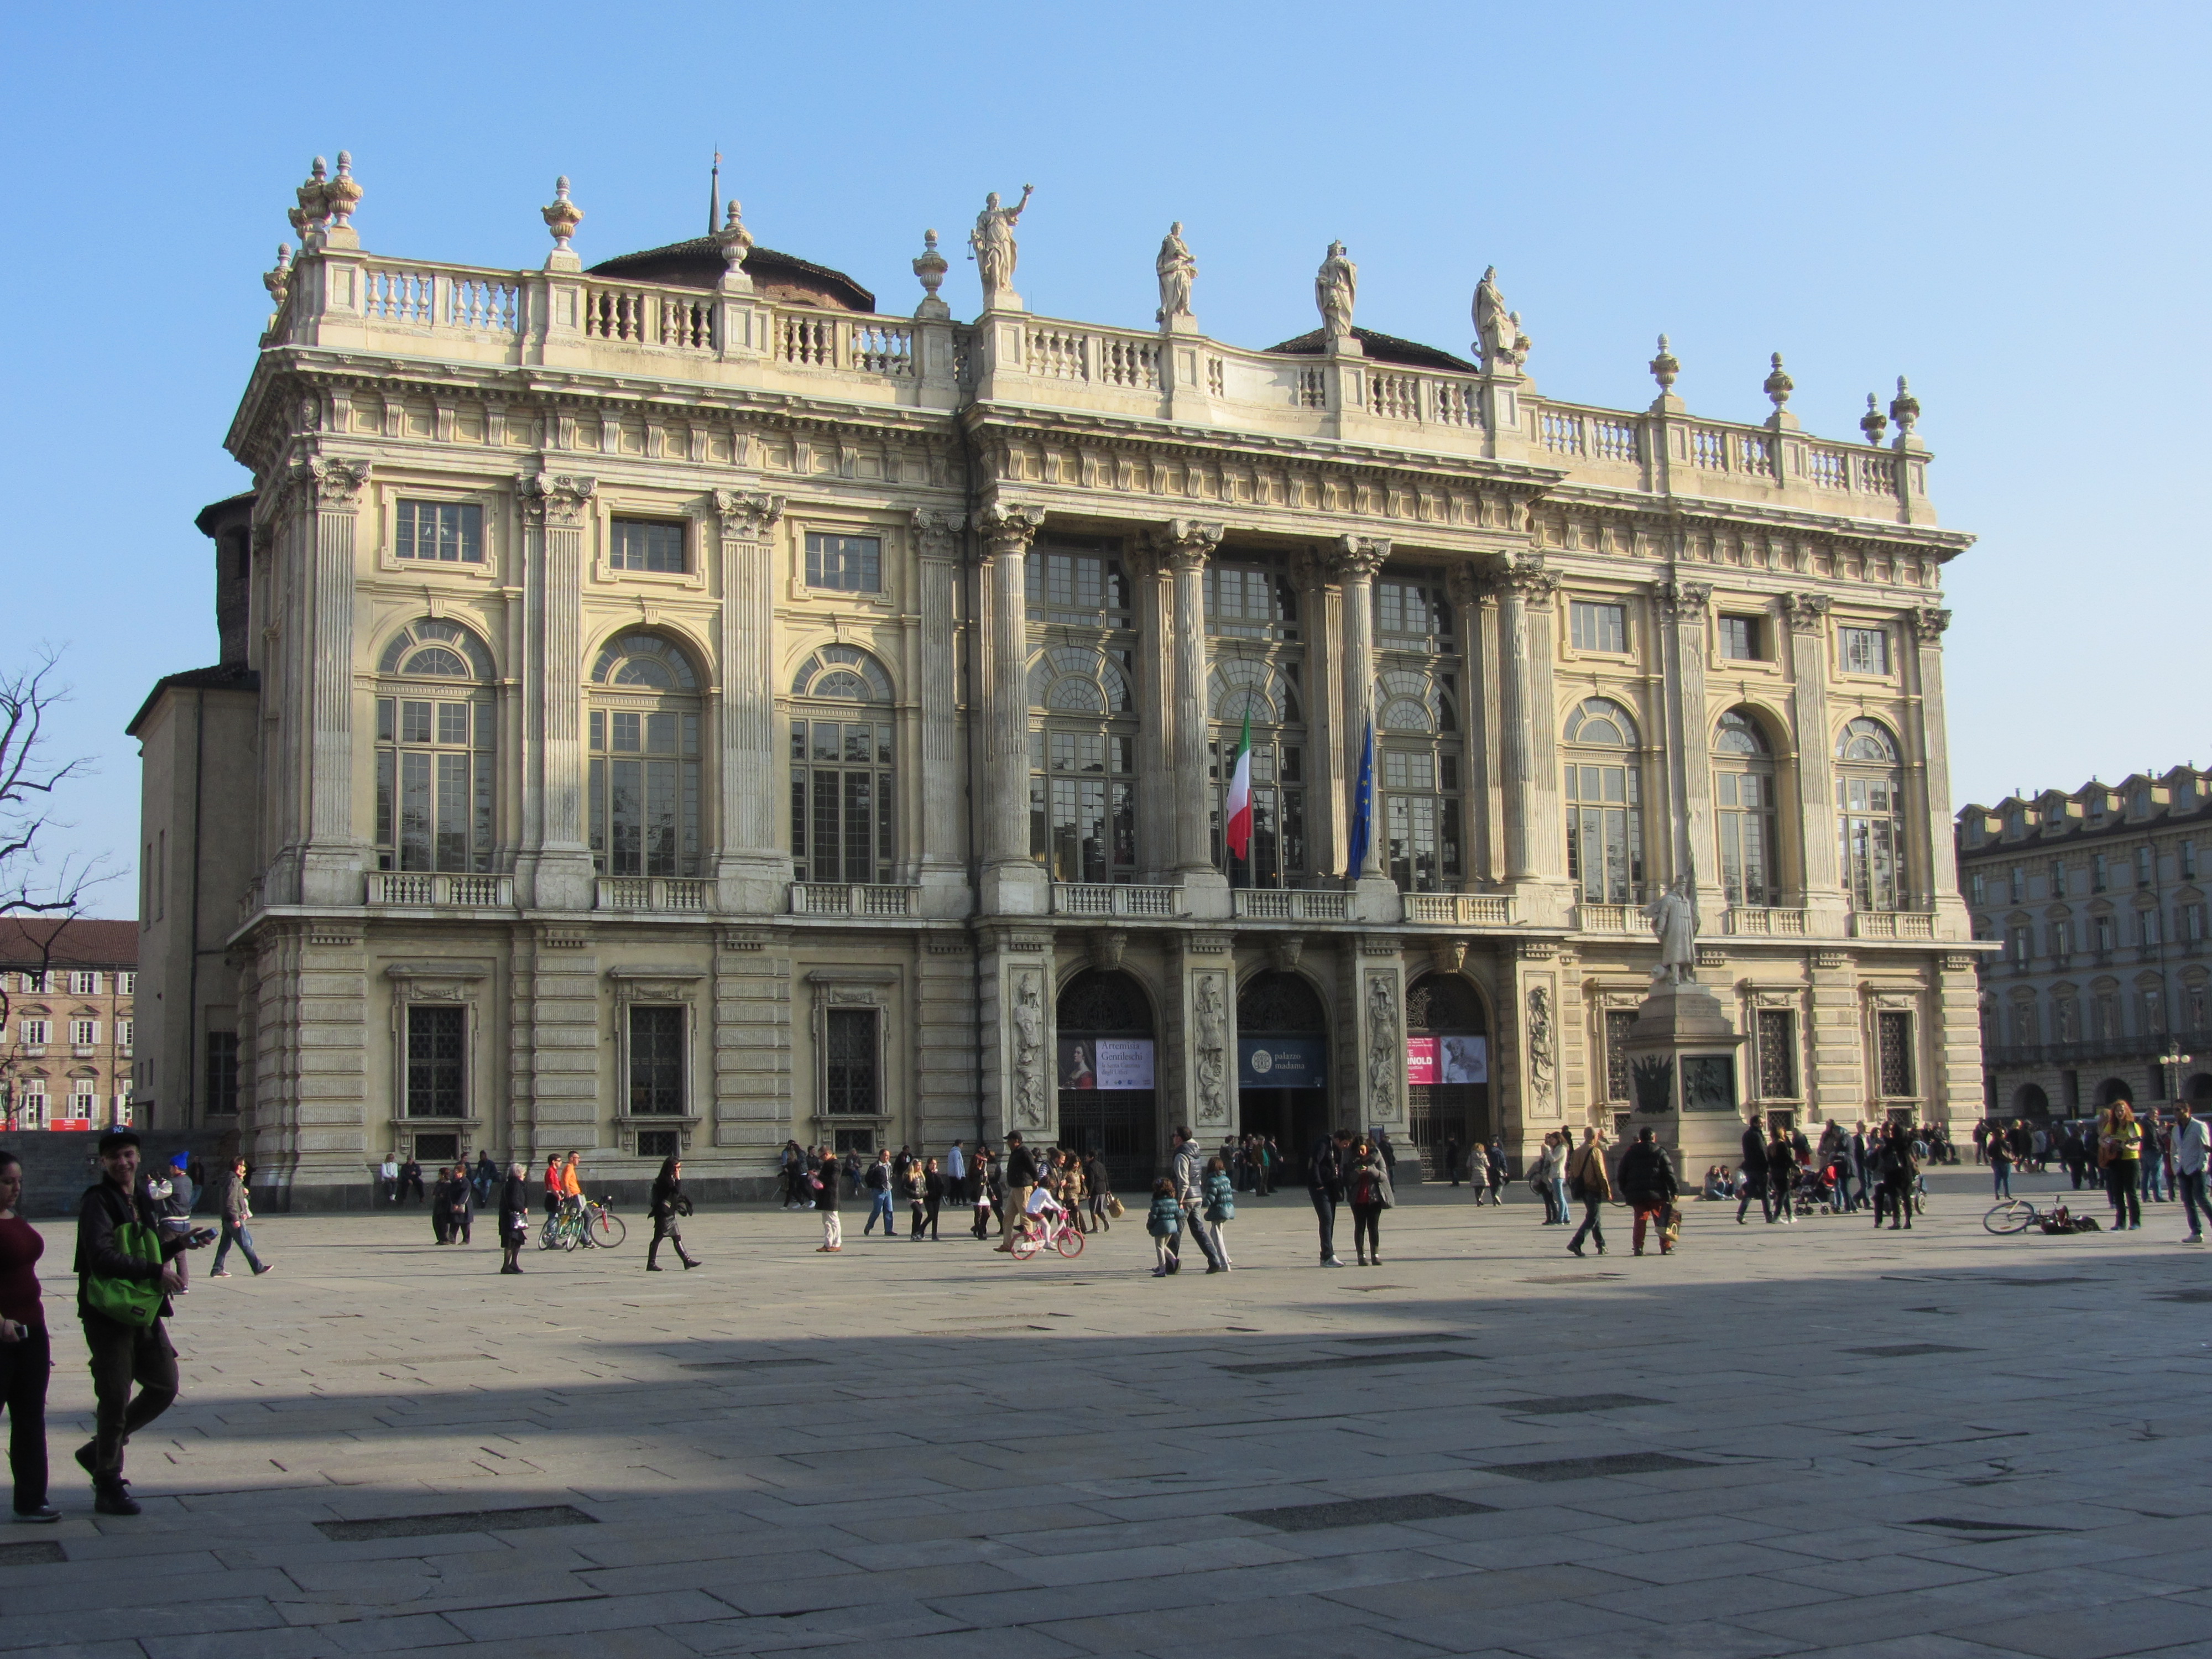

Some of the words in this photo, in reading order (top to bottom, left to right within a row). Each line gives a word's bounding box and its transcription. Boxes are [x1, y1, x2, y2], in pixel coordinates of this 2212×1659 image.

[1101, 1041, 1140, 1050] Artemisia
[1101, 1052, 1143, 1061] Gentileschi
[1275, 1051, 1301, 1062] palazzo
[1275, 1061, 1305, 1070] madama
